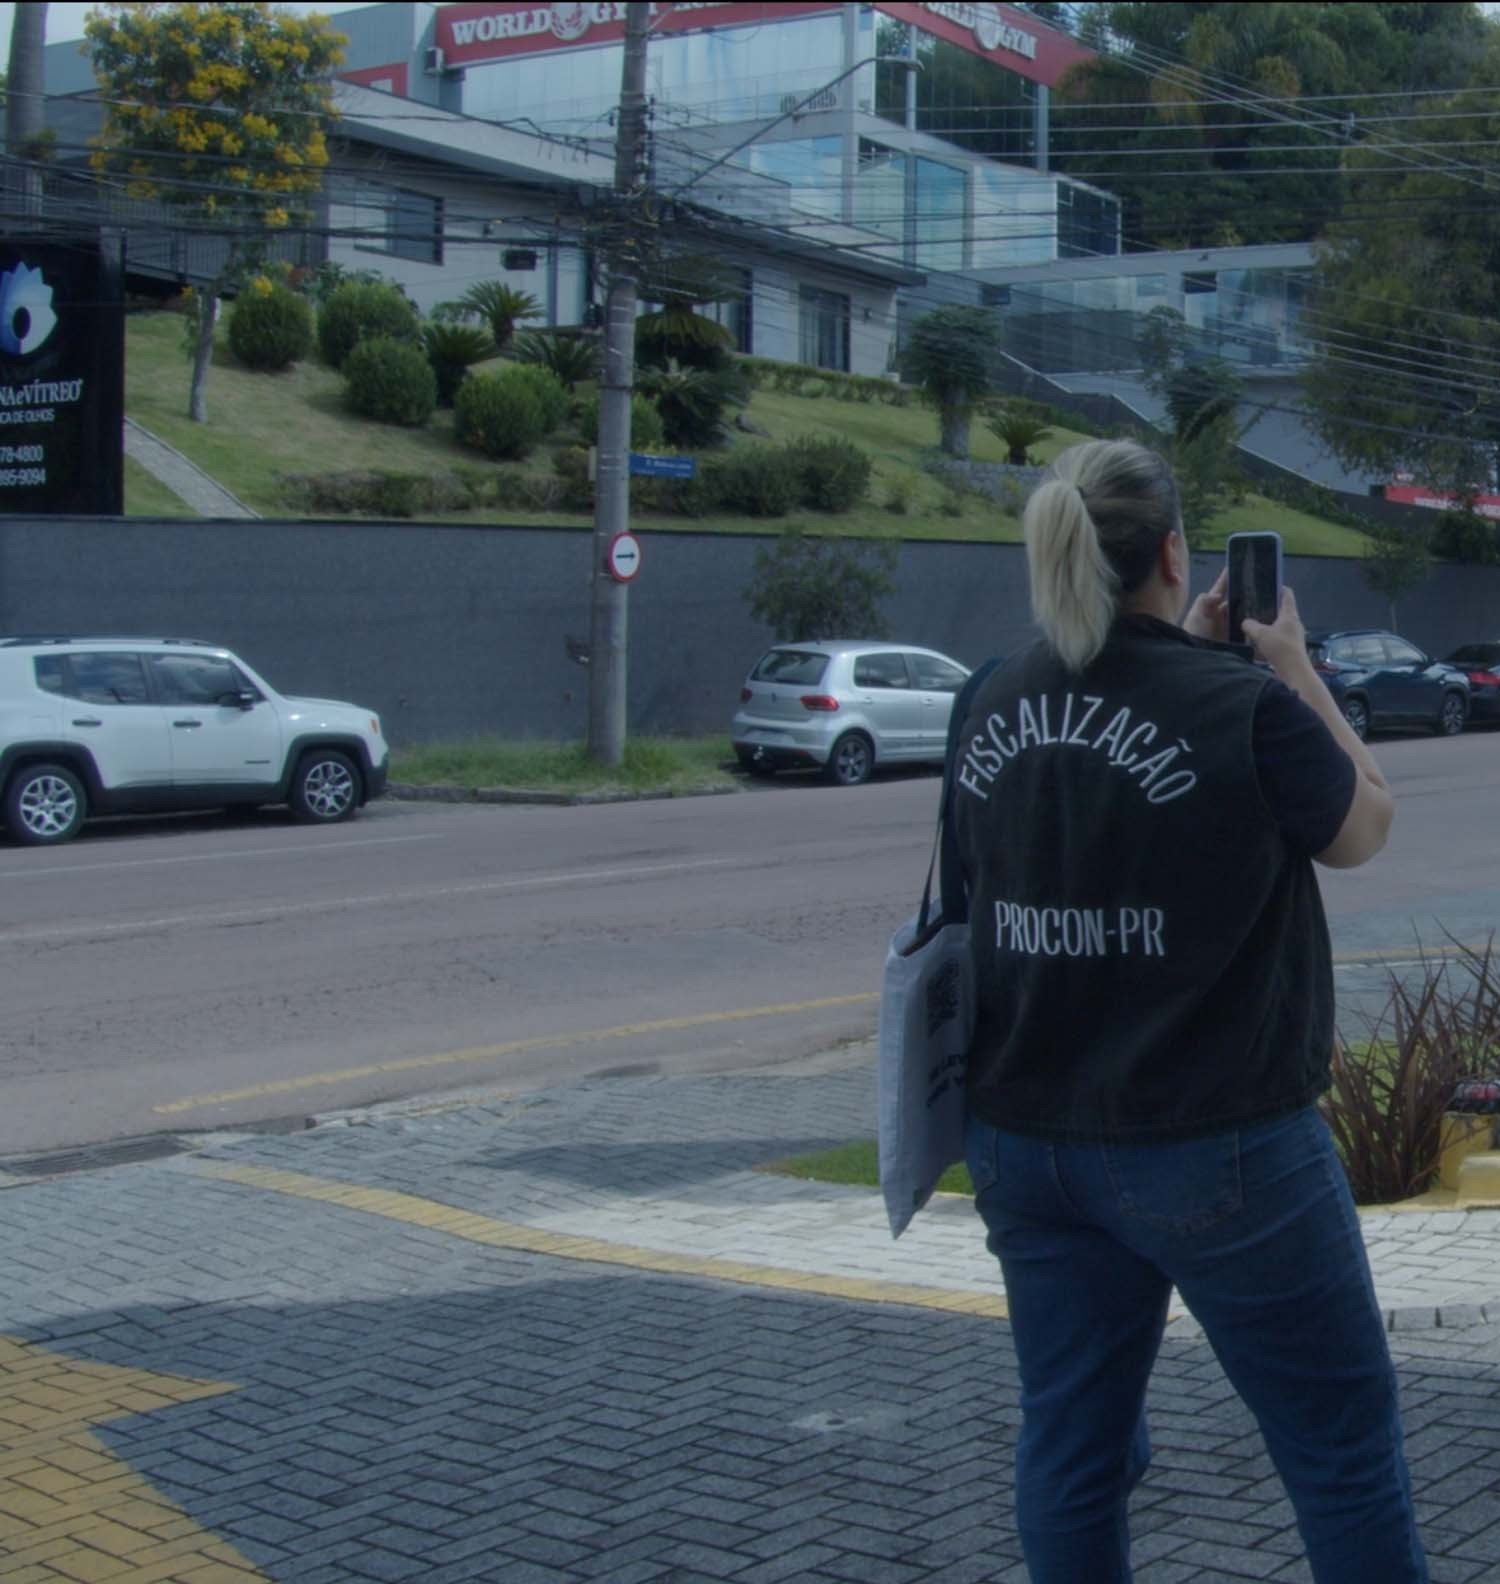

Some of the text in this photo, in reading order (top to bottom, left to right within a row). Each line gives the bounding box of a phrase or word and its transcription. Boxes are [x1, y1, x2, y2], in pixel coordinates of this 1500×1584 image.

[452, 9, 551, 46] WORLD
[959, 693, 1197, 803] FISCALIZAÇÃO
[995, 900, 1165, 956] PROCON-PR
